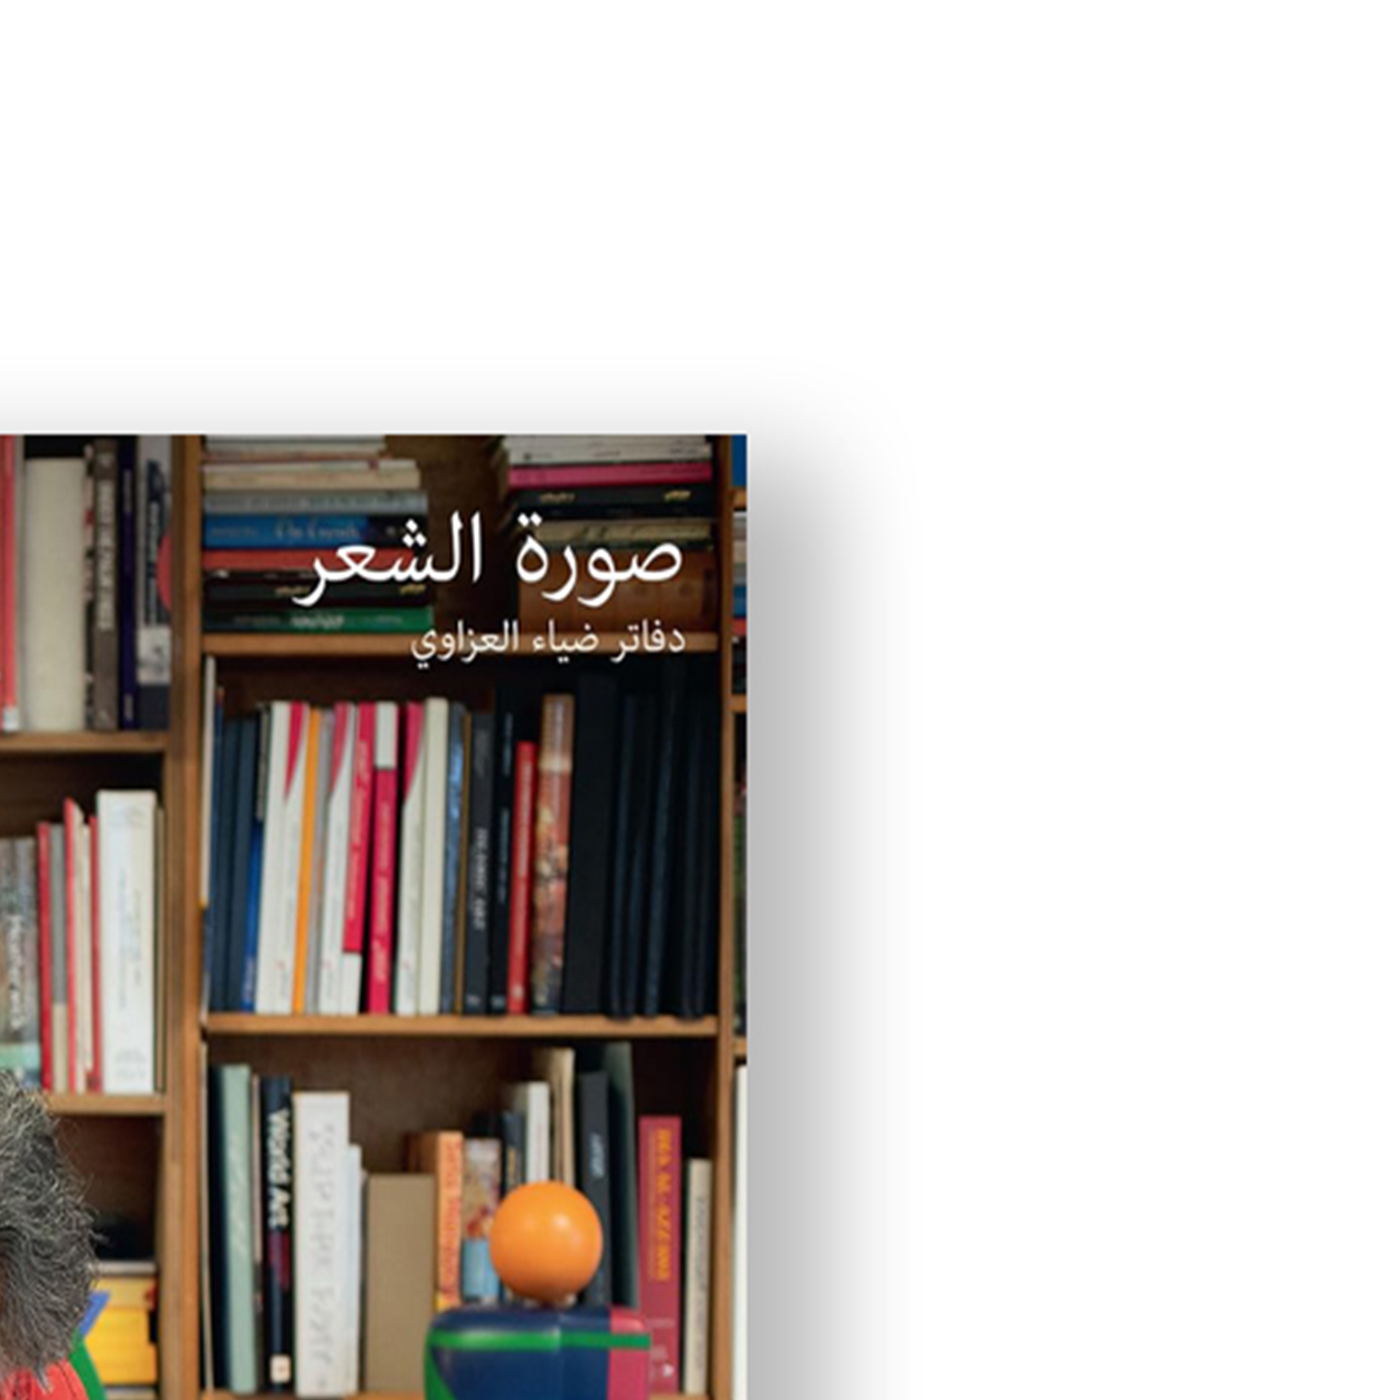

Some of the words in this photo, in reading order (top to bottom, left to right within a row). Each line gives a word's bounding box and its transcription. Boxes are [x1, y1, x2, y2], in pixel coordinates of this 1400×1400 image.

[292, 511, 482, 606] الشعر
[515, 511, 682, 607] صورة
[411, 620, 519, 669] العزاوي
[532, 619, 599, 664] ضياء
[612, 620, 686, 663] دفاتر
[268, 1187, 291, 1230] Art
